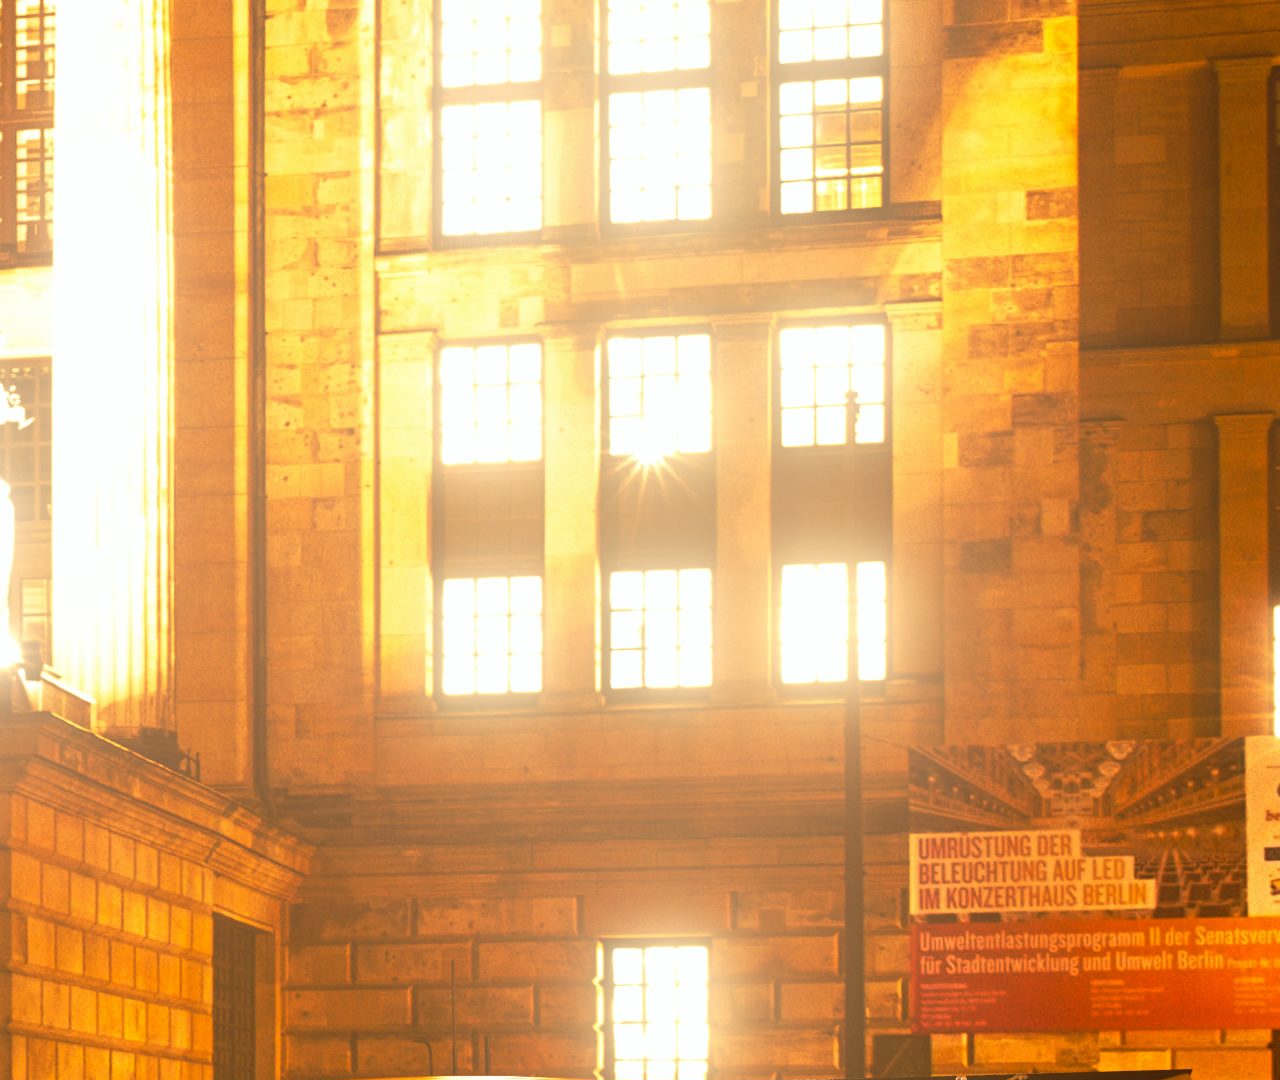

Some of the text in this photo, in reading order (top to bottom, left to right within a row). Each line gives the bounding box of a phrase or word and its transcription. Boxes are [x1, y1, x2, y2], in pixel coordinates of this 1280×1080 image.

[918, 832, 1073, 860] UMRÜSTUNG DER
[918, 858, 1125, 885] BELEUCHTUNG AUF LED
[918, 883, 1147, 910] IM KONZERTHAUS BERLIN
[919, 930, 1145, 952] Umweltentlastungsprogramm
[1165, 926, 1190, 946] der
[920, 955, 942, 975] für
[945, 953, 1079, 976] Stadtentwicklung
[1083, 951, 1111, 971] und
[1115, 950, 1173, 971] Umwelt
[1177, 950, 1224, 970] Berlin
